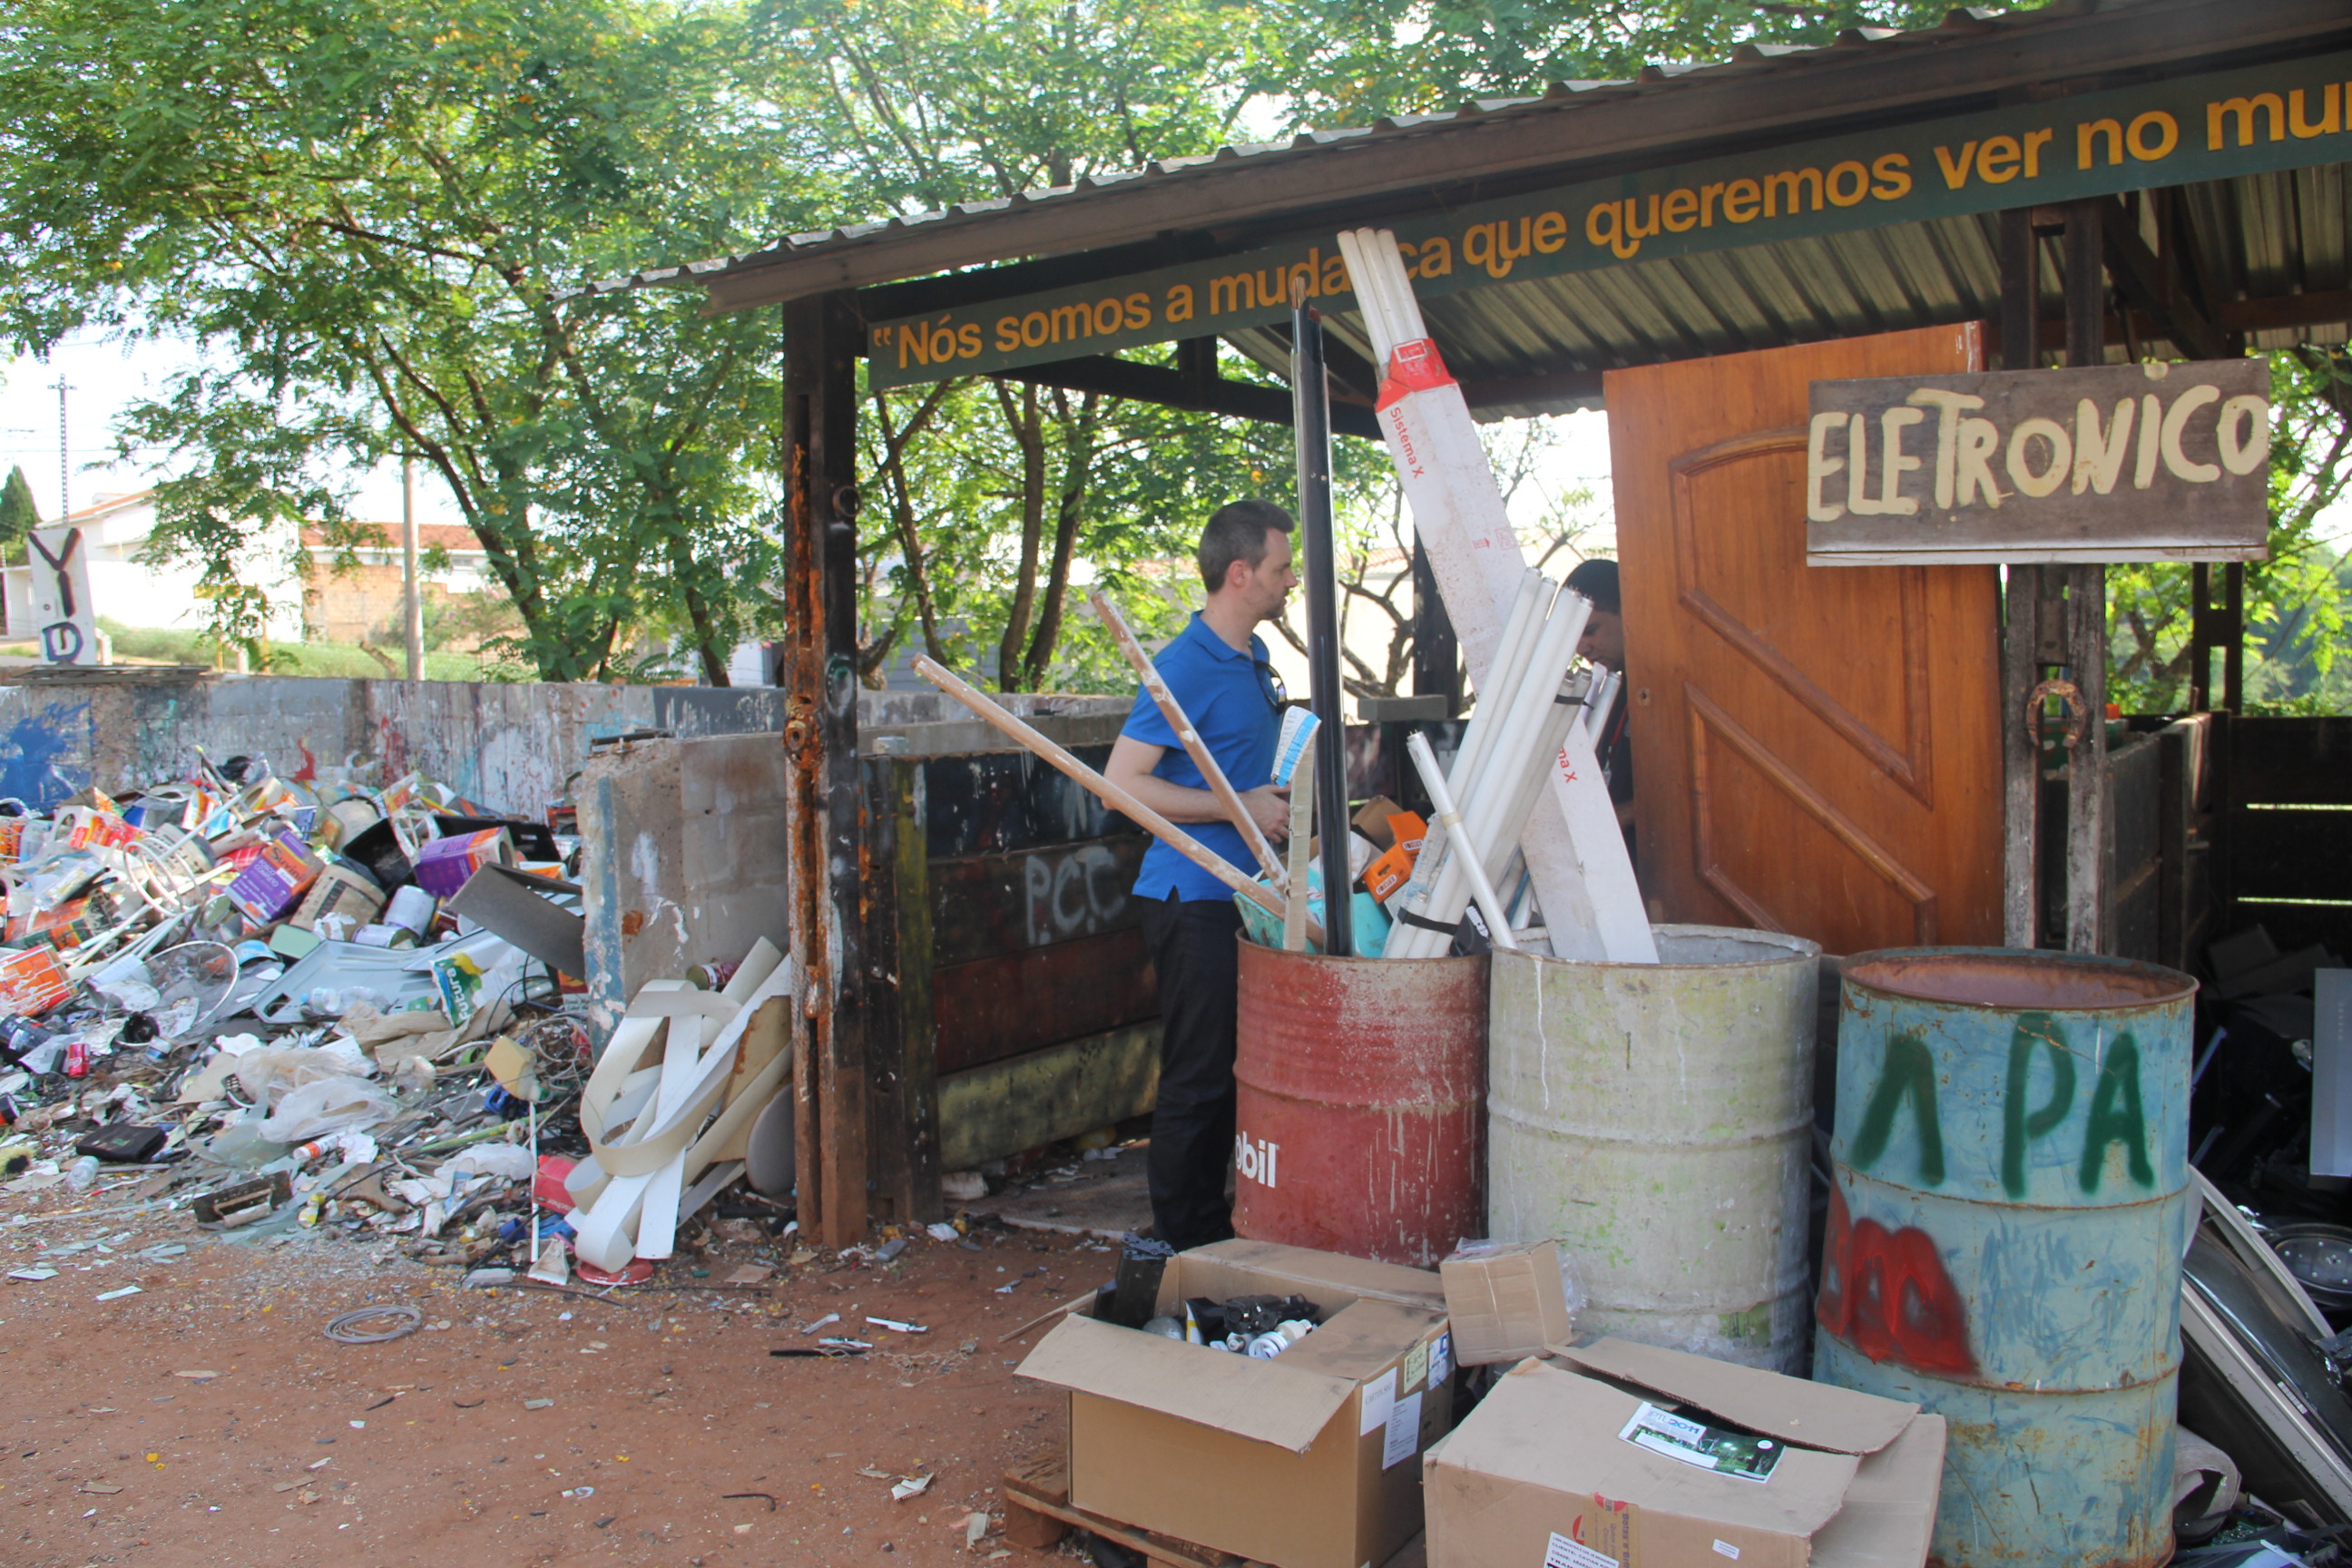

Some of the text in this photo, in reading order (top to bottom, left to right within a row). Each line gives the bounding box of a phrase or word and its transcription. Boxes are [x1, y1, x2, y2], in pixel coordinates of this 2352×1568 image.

[995, 291, 1152, 353] somos
[1165, 284, 1193, 324] a
[1462, 209, 1568, 279] que
[1584, 152, 1913, 260] queremos
[1935, 126, 2053, 191] ver
[2077, 110, 2179, 170] no
[2206, 80, 2352, 151] mu
[1390, 407, 1425, 479] Sistema X
[272, 846, 307, 884] Suvinil
[1236, 1130, 1277, 1189] obil
